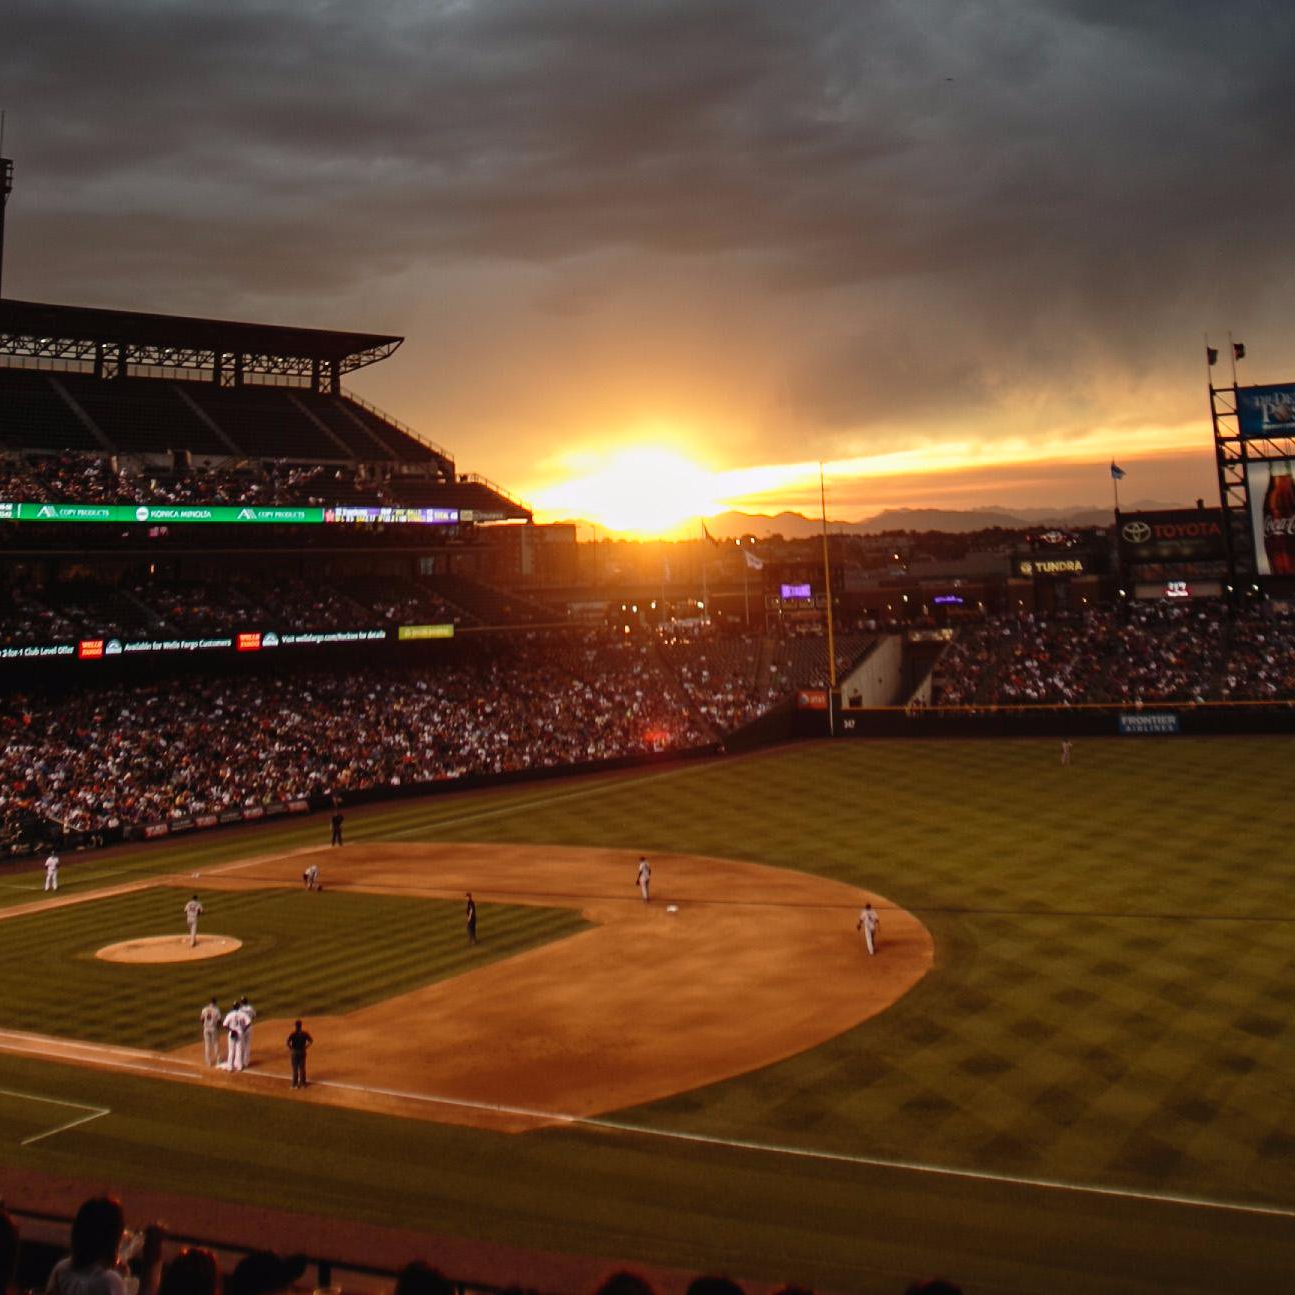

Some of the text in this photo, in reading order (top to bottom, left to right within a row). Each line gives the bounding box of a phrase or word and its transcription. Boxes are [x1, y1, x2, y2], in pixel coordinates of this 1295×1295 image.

[1154, 522, 1221, 538] TOYOTA
[1034, 560, 1084, 572] TUNDRA
[843, 719, 856, 729] 347
[1121, 715, 1176, 725] FRONTIER
